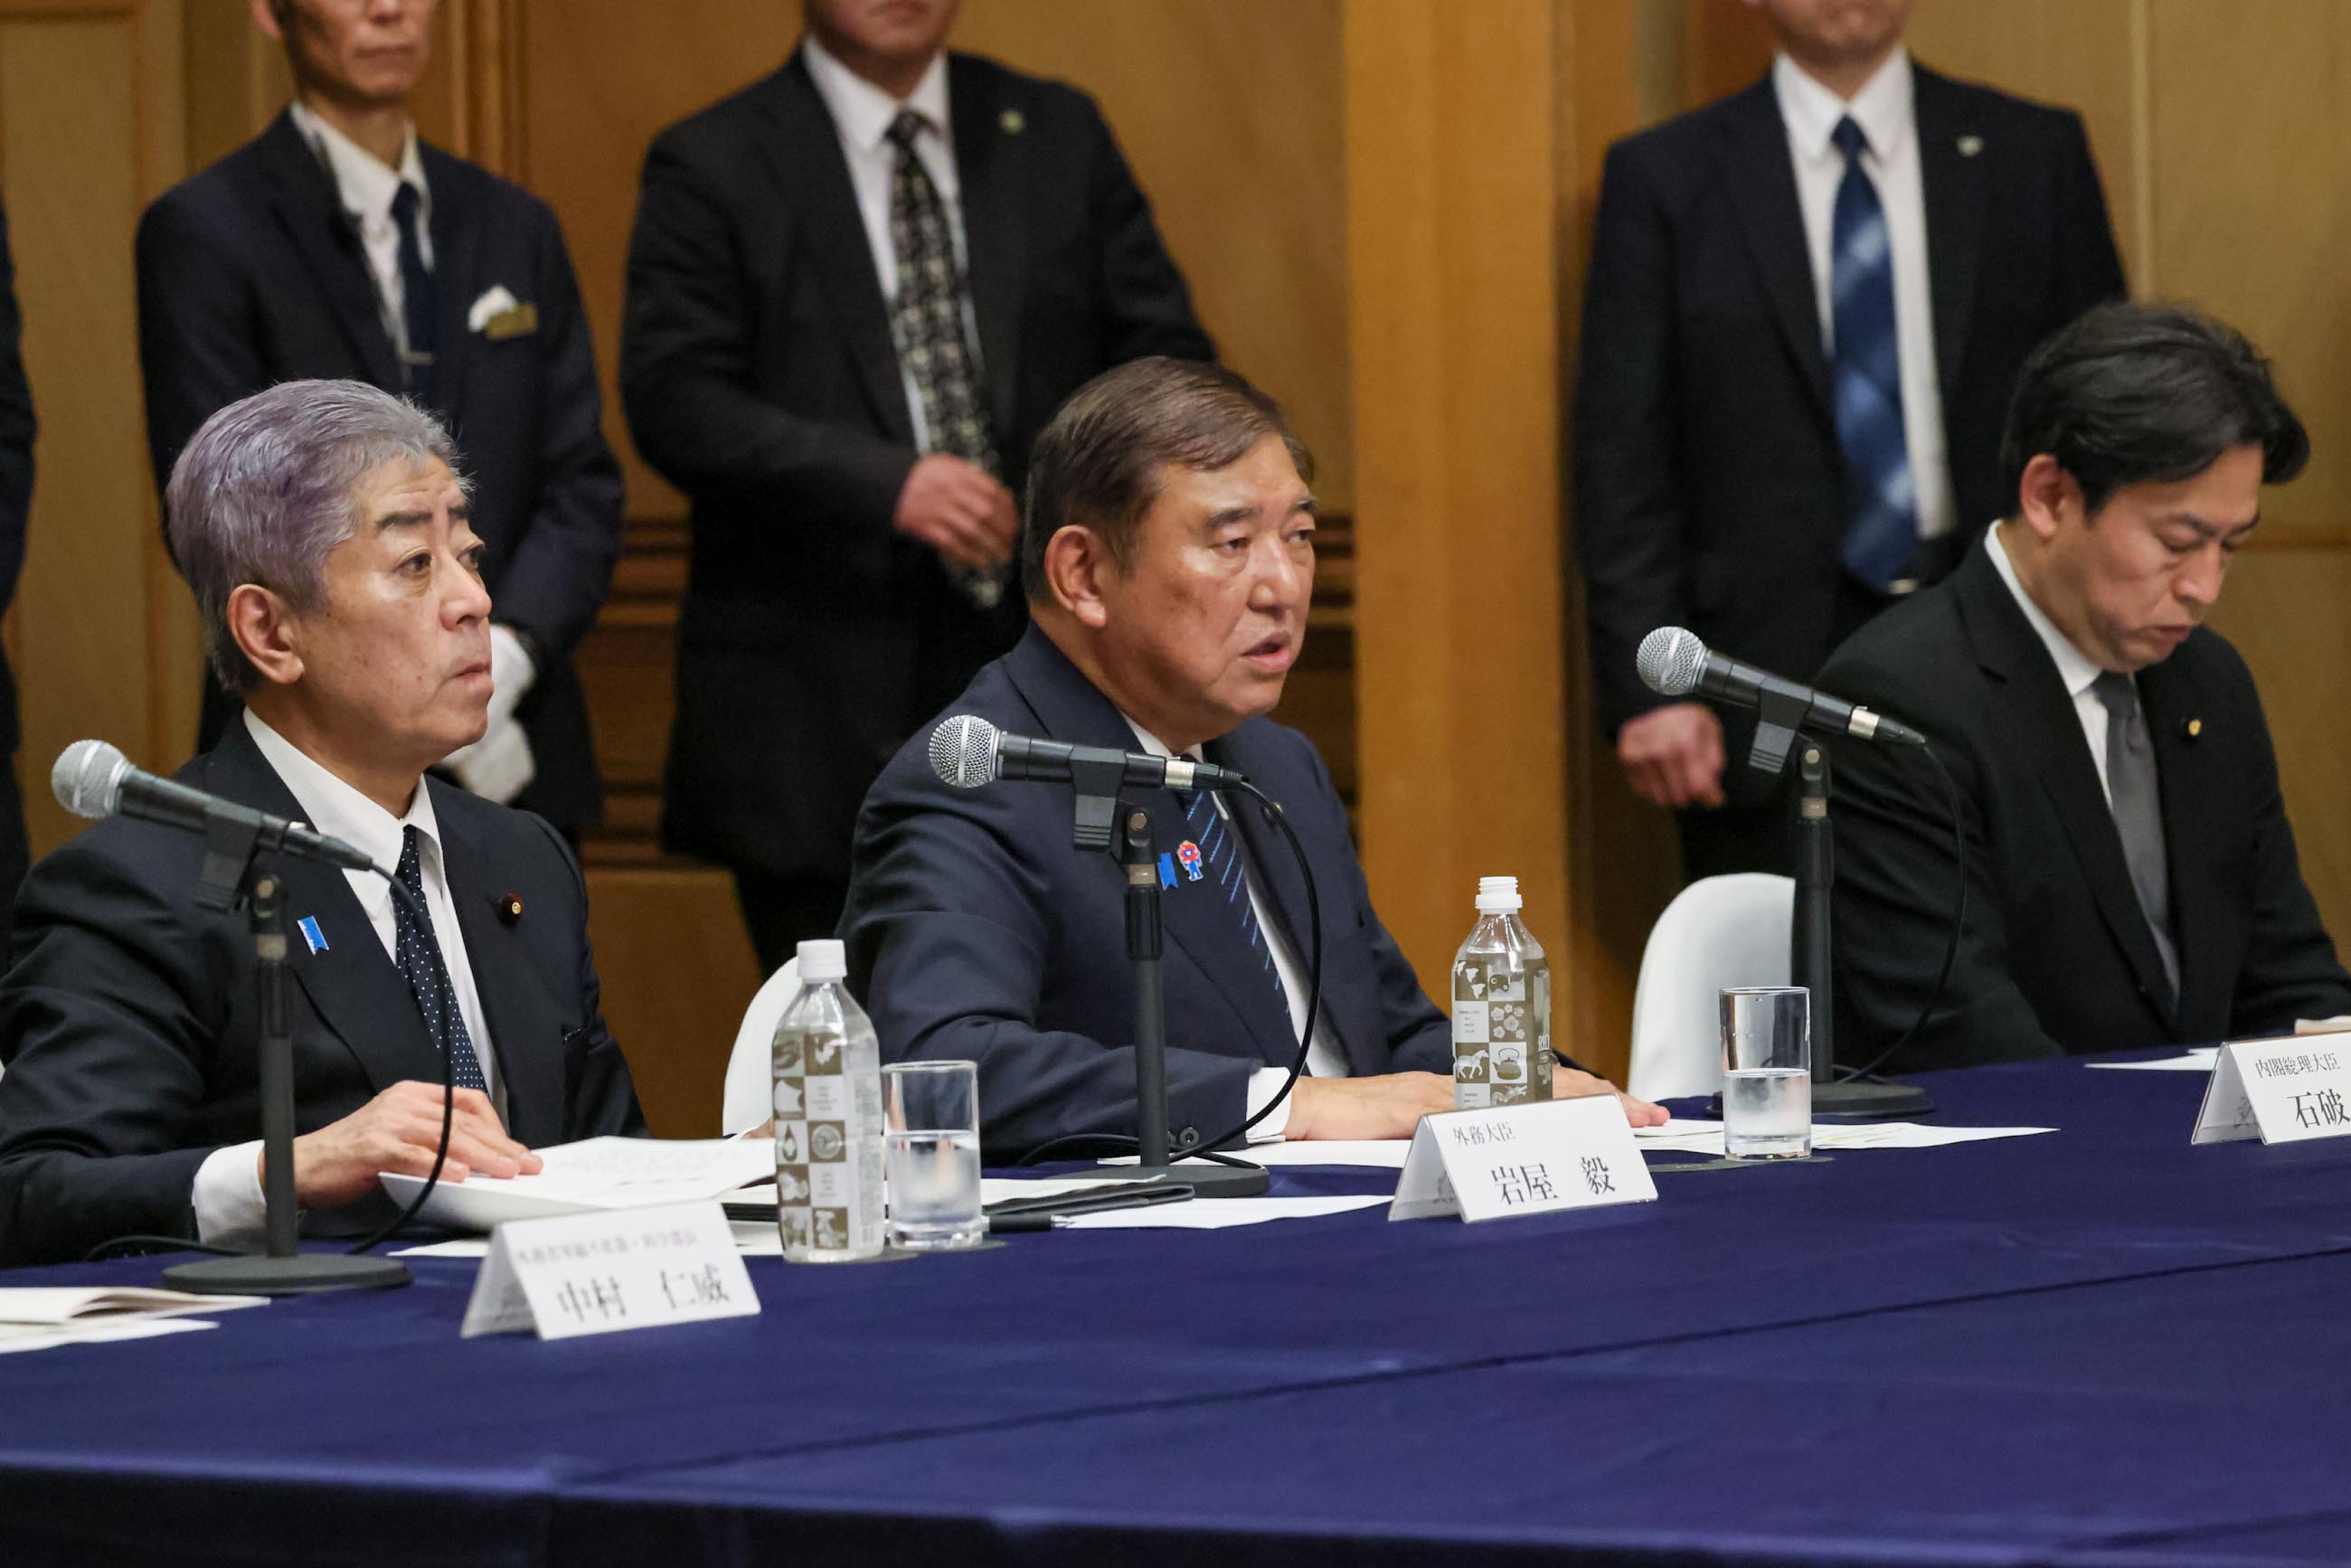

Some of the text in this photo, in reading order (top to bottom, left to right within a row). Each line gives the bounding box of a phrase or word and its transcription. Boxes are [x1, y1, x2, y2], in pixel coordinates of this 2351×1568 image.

[2255, 1053, 2340, 1078] 内閣総理大臣
[2286, 1088, 2350, 1129] 石破
[1453, 1121, 1515, 1146] 外務大臣
[1491, 1162, 1559, 1205] 岩屋
[1580, 1157, 1616, 1195] 毅
[557, 1262, 730, 1323] 中村 仁威
